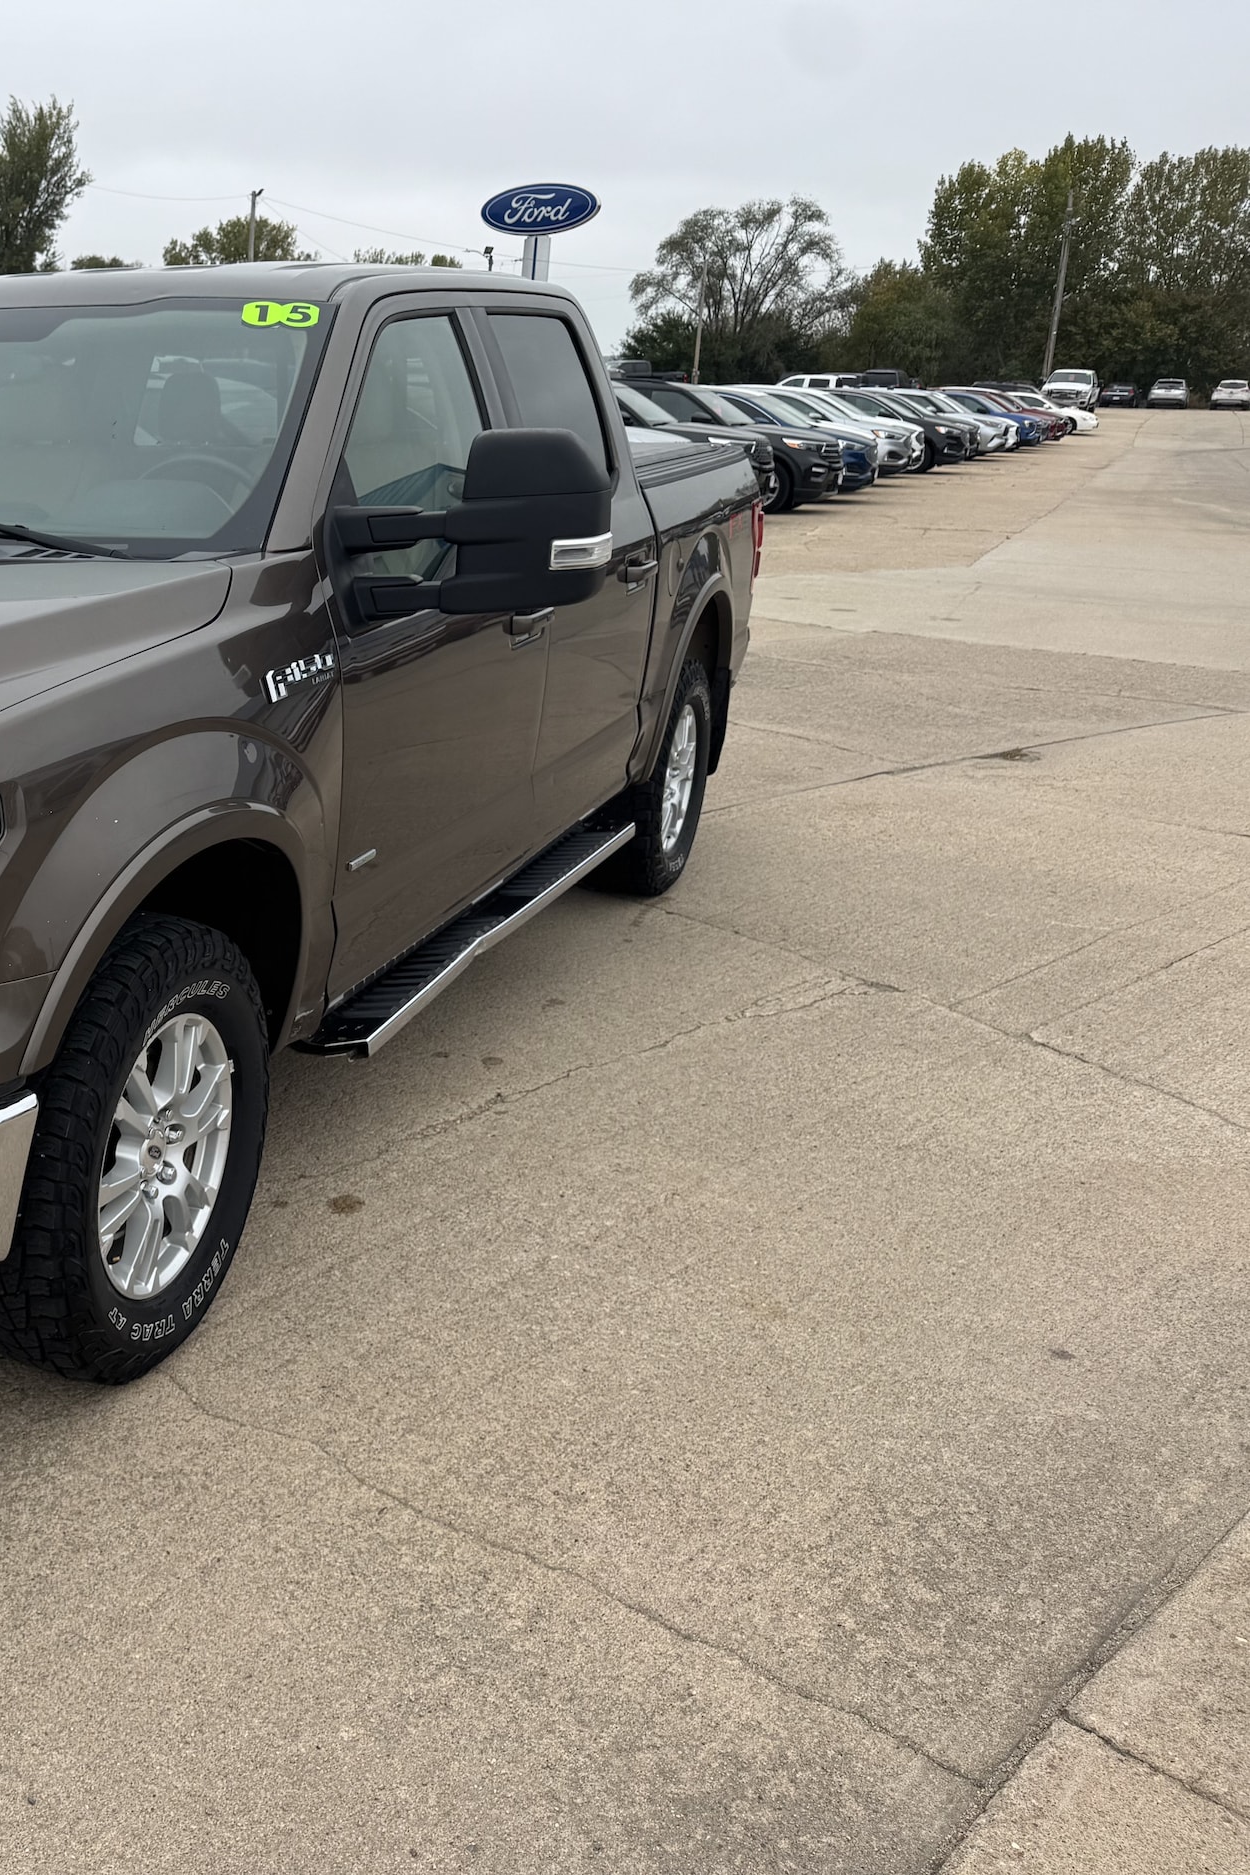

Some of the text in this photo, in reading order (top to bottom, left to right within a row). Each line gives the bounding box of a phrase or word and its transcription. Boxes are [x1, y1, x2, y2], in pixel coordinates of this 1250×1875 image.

[503, 193, 572, 224] Ford
[311, 671, 335, 685] LARIAT
[142, 979, 231, 1047] HERCULES
[181, 1238, 230, 1320] TERRA
[130, 1314, 176, 1341] TRAC
